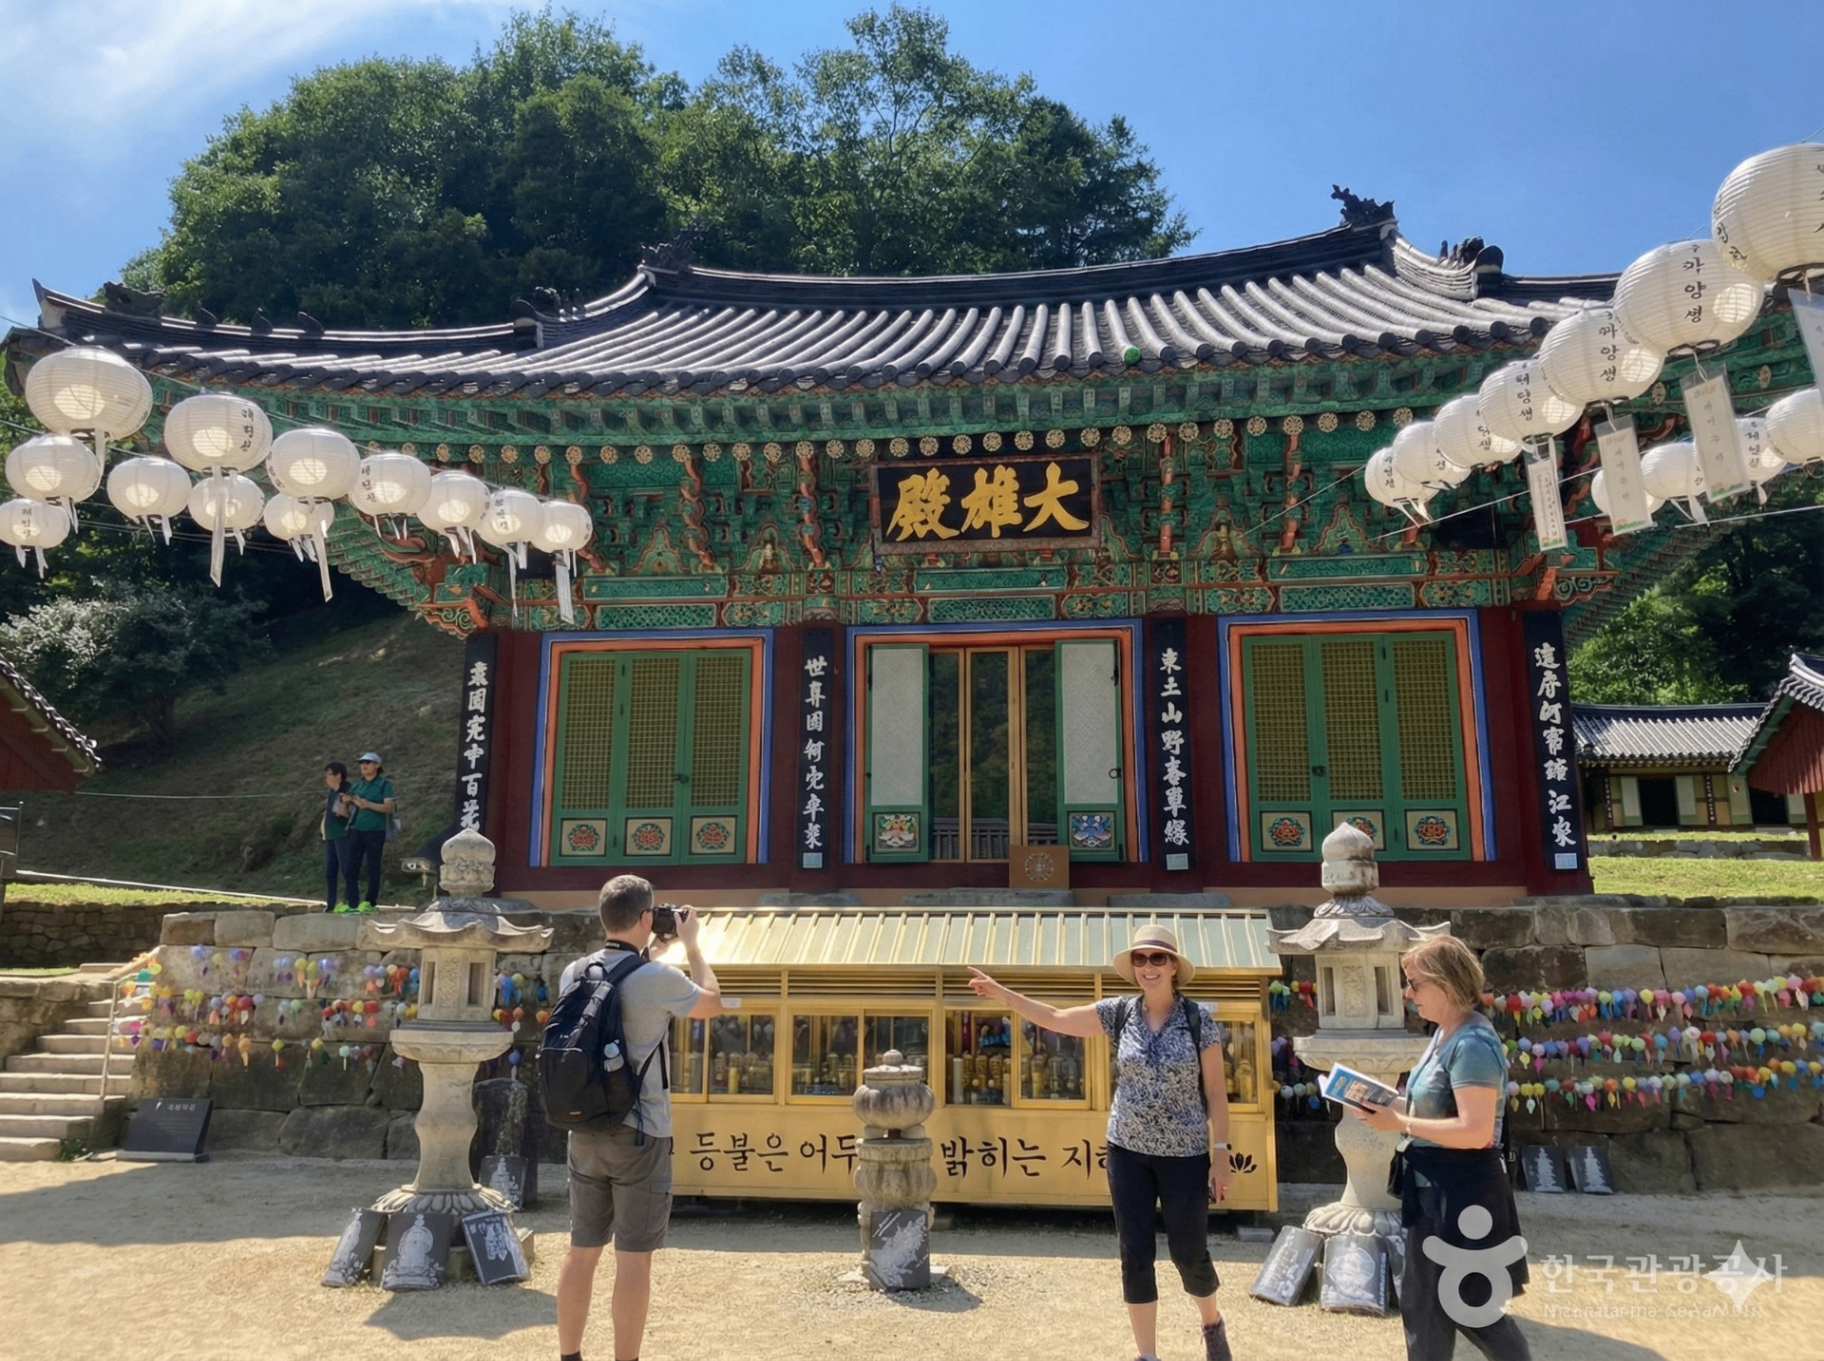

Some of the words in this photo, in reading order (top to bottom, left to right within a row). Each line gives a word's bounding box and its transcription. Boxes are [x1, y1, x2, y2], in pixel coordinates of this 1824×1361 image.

[886, 462, 1089, 541] 大雄殿
[689, 1132, 789, 1172] 등불은
[799, 1133, 858, 1175] 어두
[940, 1136, 1047, 1179] 밝히는
